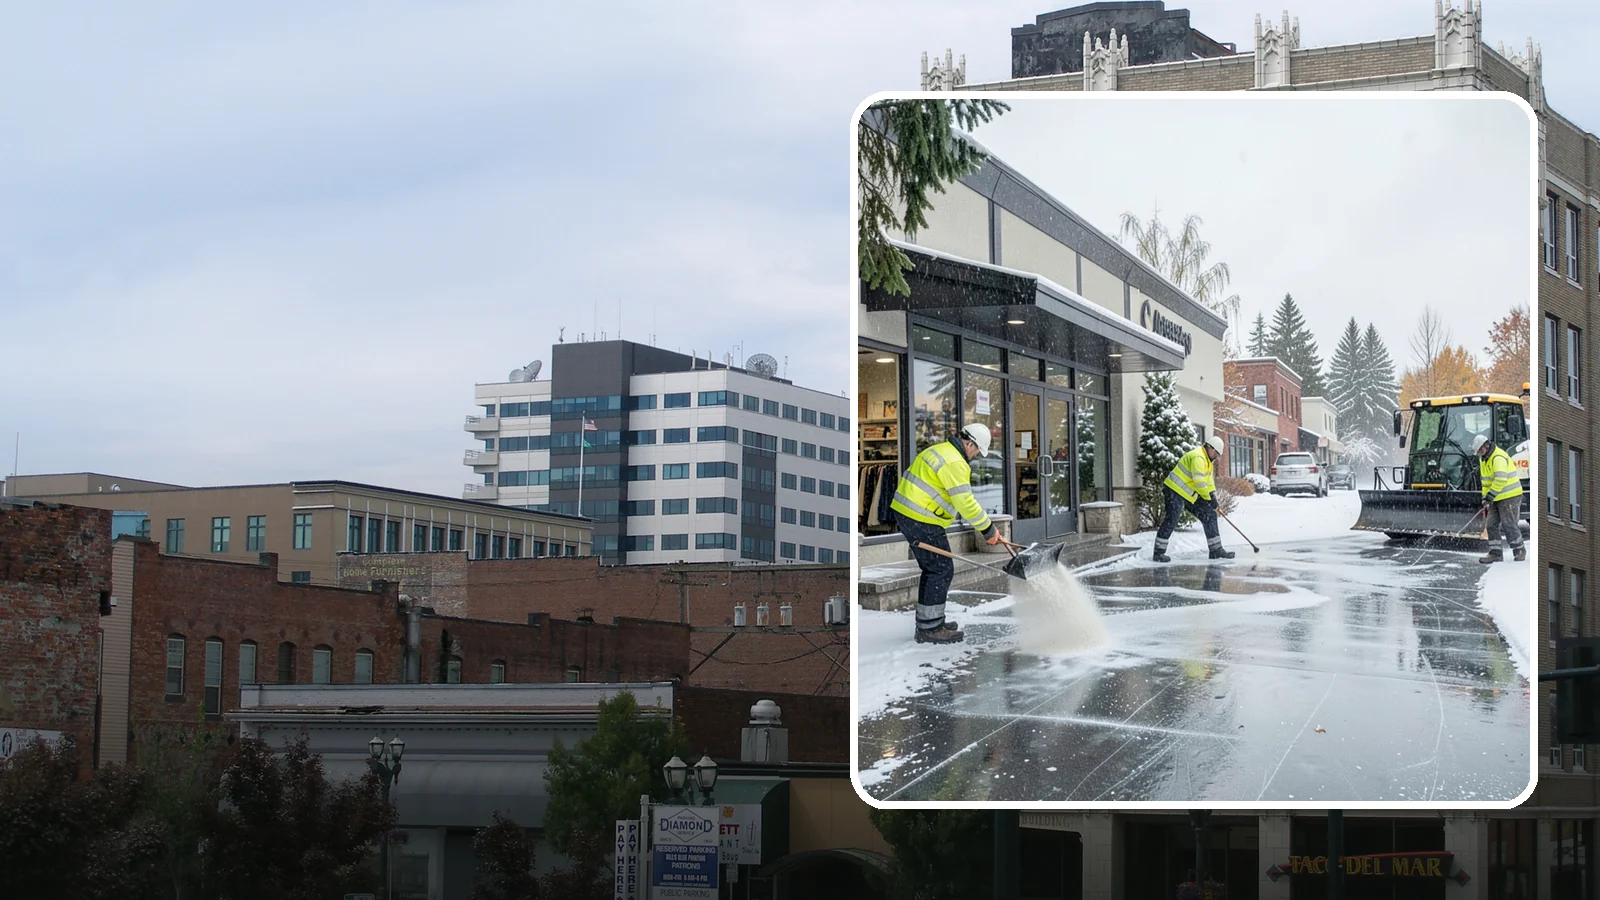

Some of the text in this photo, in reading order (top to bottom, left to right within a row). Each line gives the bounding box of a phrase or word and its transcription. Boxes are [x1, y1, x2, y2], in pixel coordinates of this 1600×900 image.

[343, 566, 428, 576] Home Furnishers
[660, 818, 713, 832] DIAMOND
[1022, 815, 1070, 828] BUILDING
[722, 852, 739, 862] Soup
[1288, 856, 1442, 877] TAC DEL MAR
[616, 855, 625, 893] HERE
[628, 855, 636, 893] HERE
[684, 890, 710, 898] PARKING
